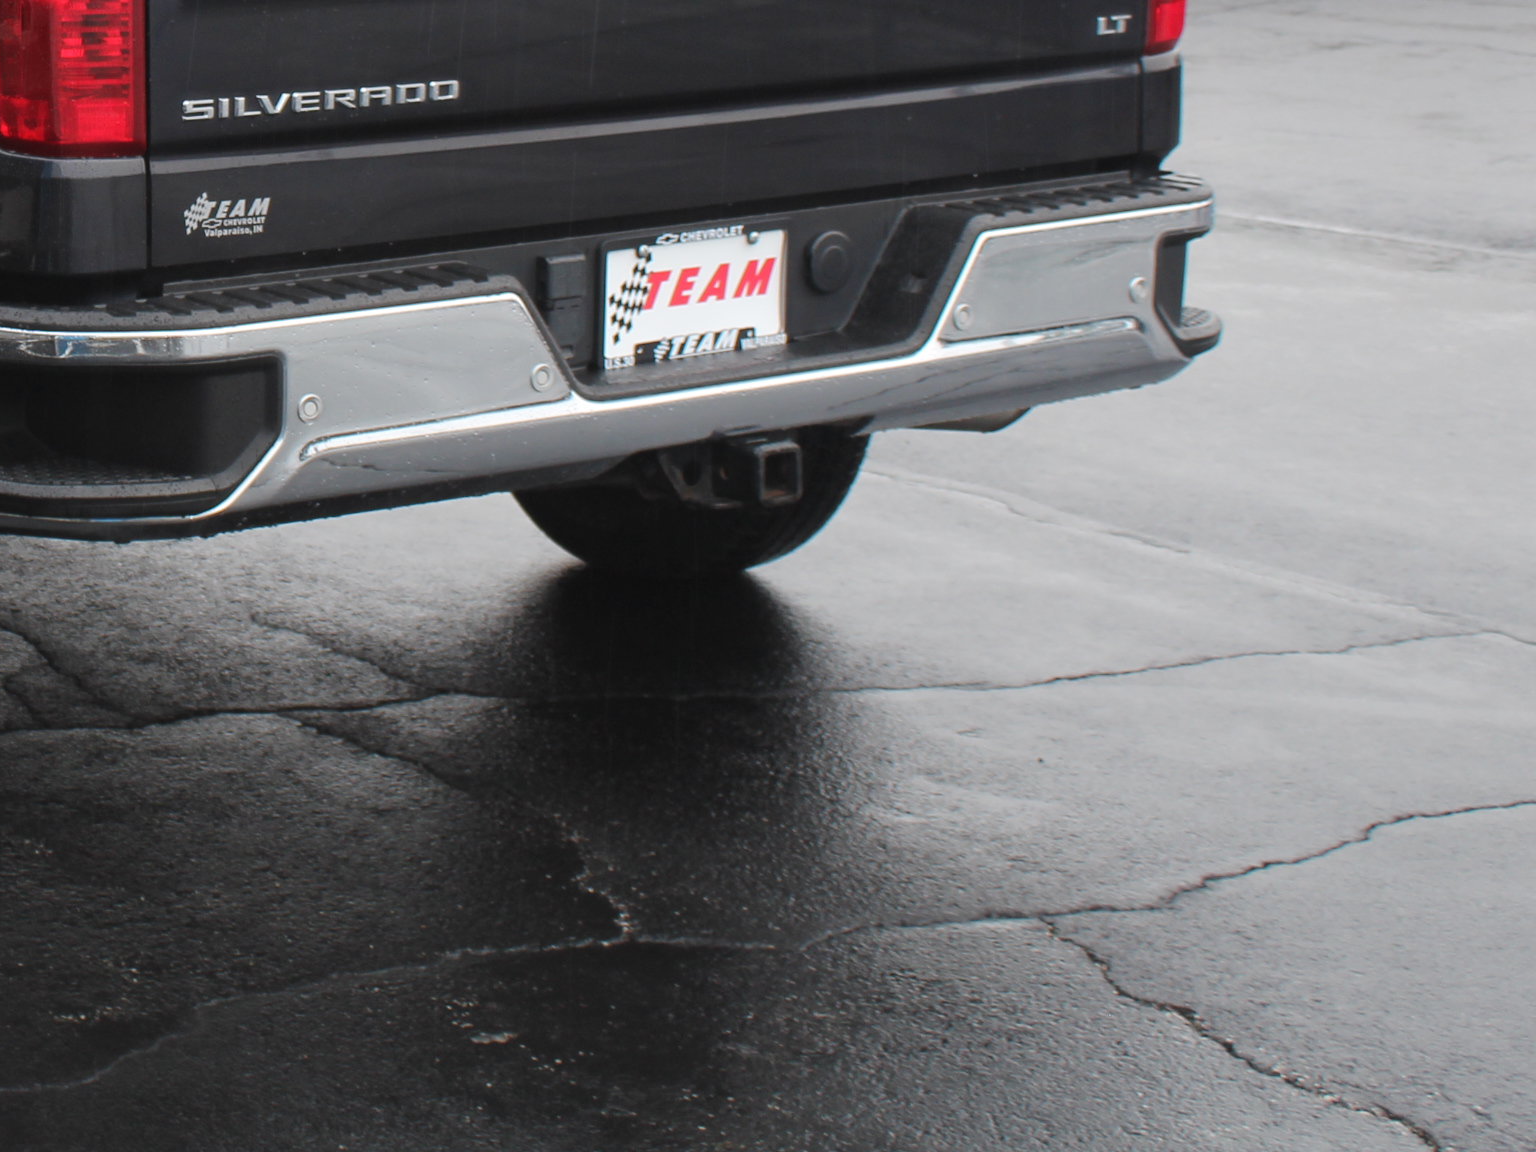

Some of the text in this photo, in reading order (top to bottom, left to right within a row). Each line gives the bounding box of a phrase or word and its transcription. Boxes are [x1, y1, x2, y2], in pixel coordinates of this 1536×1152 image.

[1096, 14, 1132, 35] LT
[182, 80, 459, 121] SILVERADO
[201, 197, 271, 219] TEAM
[223, 217, 266, 227] CHEVROLET
[253, 225, 264, 234] IN
[679, 225, 745, 244] CHEVROLET
[643, 257, 777, 311] TEAM
[669, 329, 739, 359] TEAM
